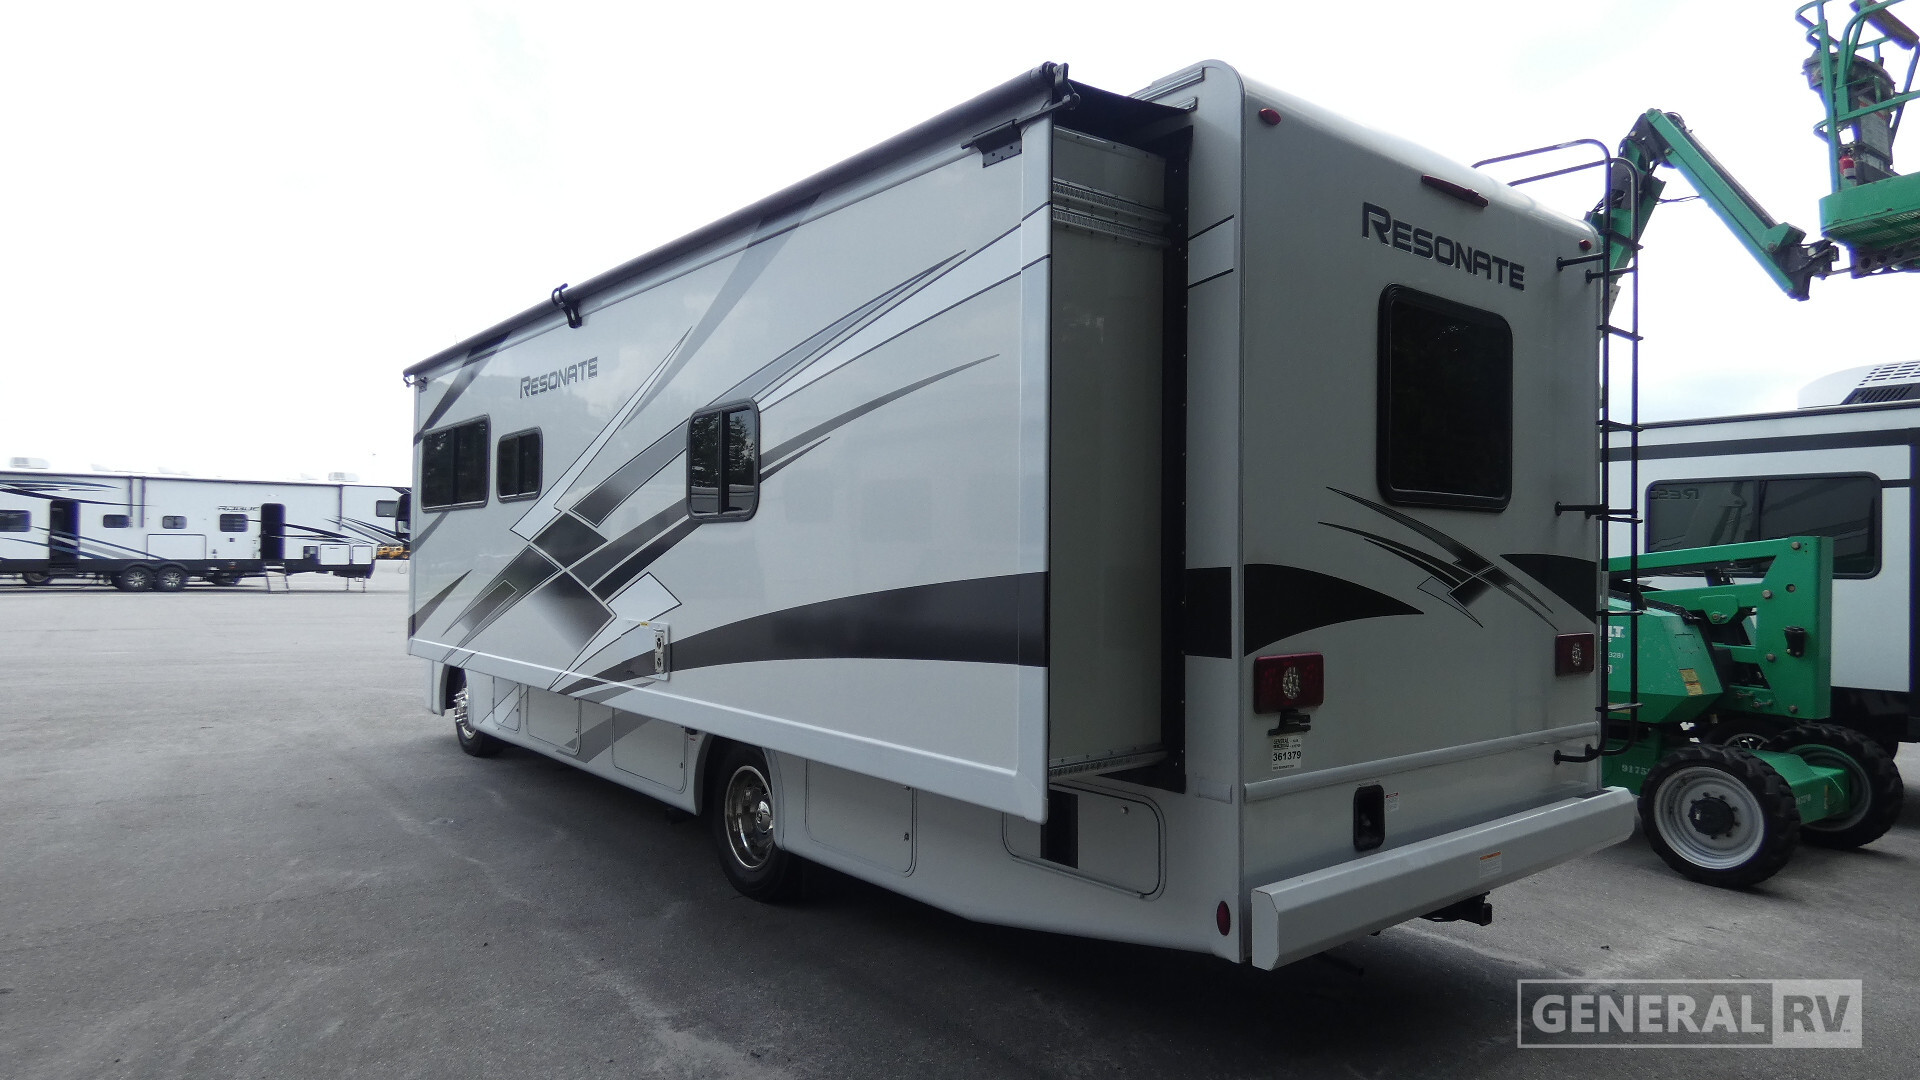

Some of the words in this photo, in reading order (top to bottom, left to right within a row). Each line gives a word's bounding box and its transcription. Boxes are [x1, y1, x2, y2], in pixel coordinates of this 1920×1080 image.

[1361, 201, 1525, 291] RESONATE
[520, 356, 598, 399] RESONATE
[1273, 751, 1302, 762] 361379
[1621, 764, 1651, 775] 9175
